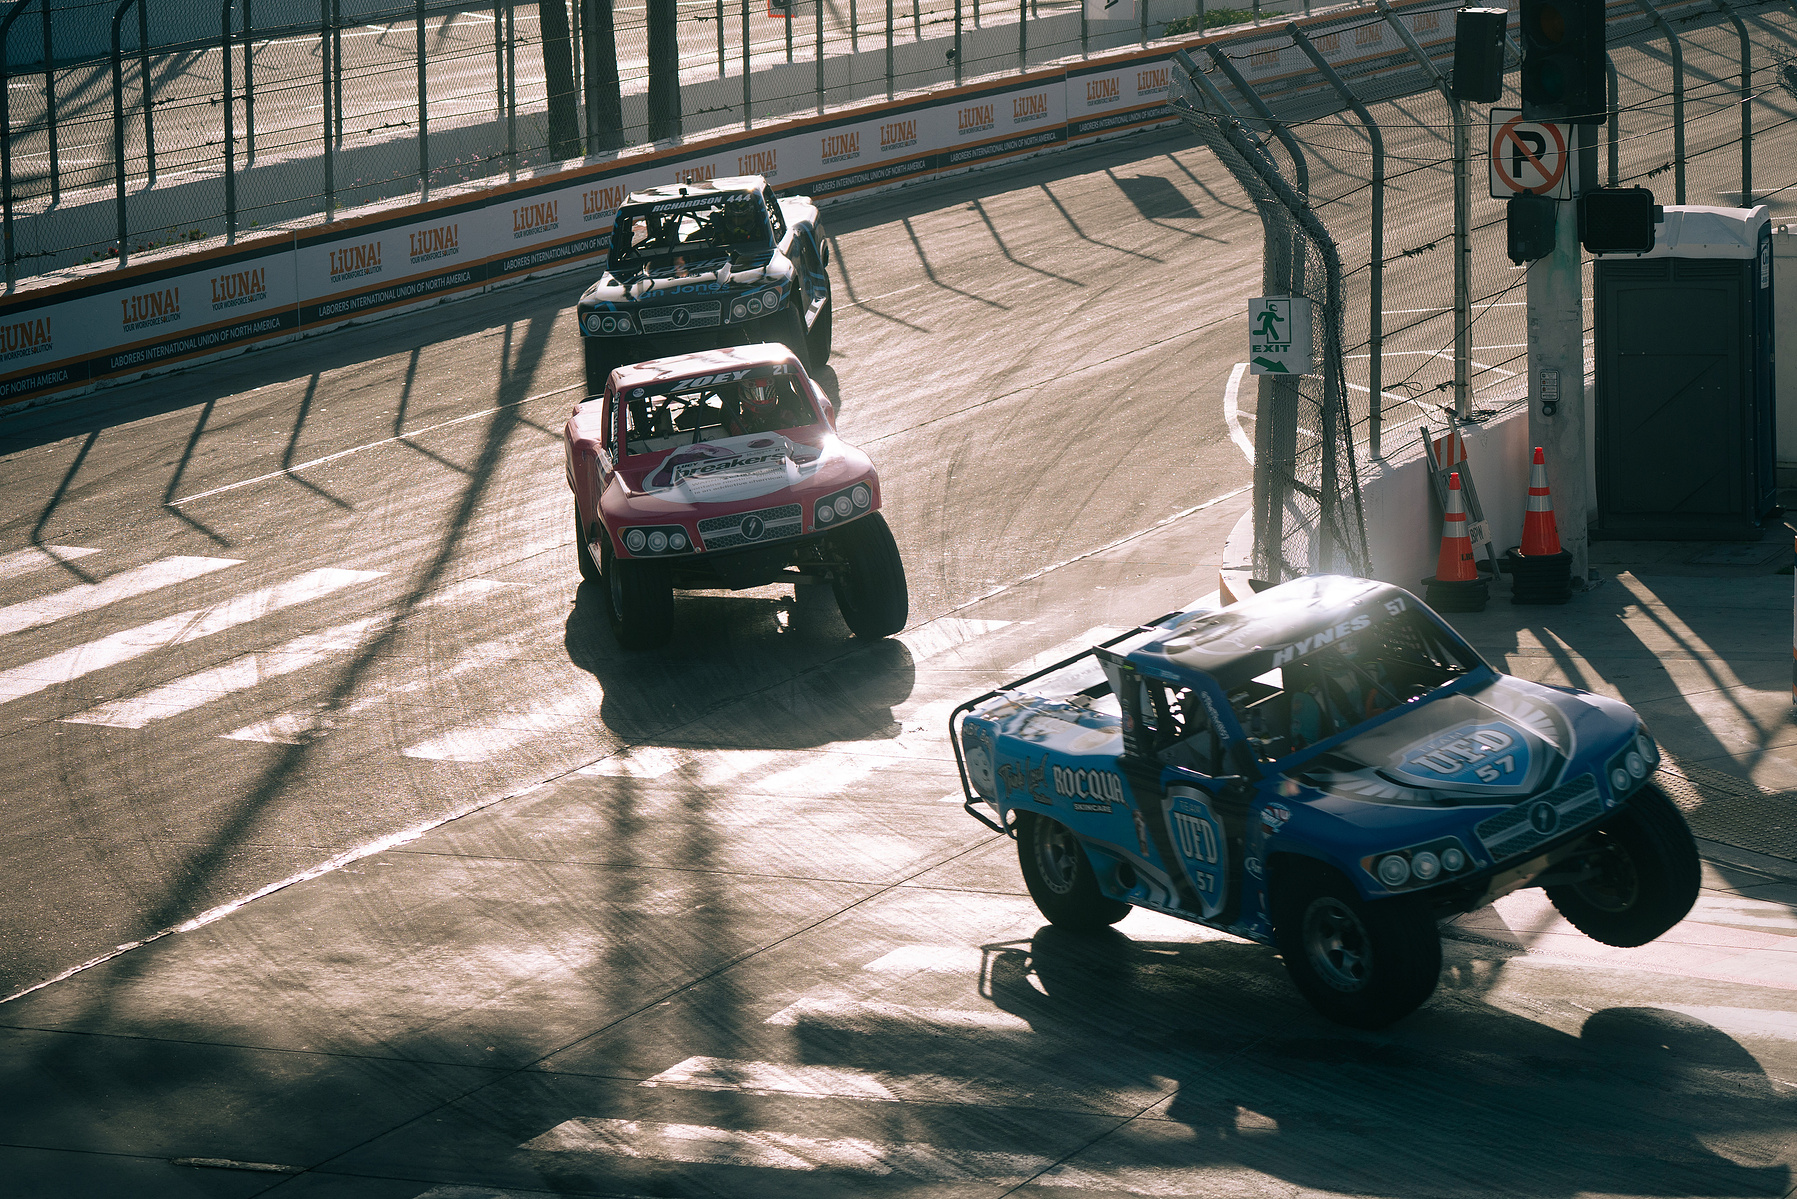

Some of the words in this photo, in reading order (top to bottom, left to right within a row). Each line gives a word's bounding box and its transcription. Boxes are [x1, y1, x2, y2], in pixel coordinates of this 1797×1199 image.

[1086, 77, 1119, 101] LiUNA!
[1137, 68, 1169, 91] LiUNA!
[958, 104, 994, 130] LiUNA!
[1013, 93, 1047, 118] LiUNA!
[821, 131, 860, 159] LiUNA!
[880, 119, 917, 146] LiUNA!
[738, 149, 777, 176] LiUNA!
[812, 180, 836, 193] LABORERS
[836, 173, 870, 188] INTERNATIONAL
[870, 169, 885, 179] UNION
[885, 167, 892, 176] OF
[892, 164, 907, 175] NORTH
[907, 160, 926, 171] AMERICA
[513, 200, 558, 232] LiUNA!
[652, 196, 722, 213] RICHARDSON
[726, 194, 751, 203] 444
[409, 224, 458, 257] LiUNA!
[503, 256, 531, 271] LABORERS
[530, 246, 571, 265] INTERNATIONAL
[572, 241, 589, 253] UNION
[589, 239, 596, 248] OF
[597, 235, 611, 247] NORT
[329, 241, 382, 276] LiUNA!
[210, 267, 266, 303] LiUNA!
[318, 300, 349, 317] LABORERS
[350, 289, 396, 309] INTERNATIONAL
[396, 285, 416, 298] UNION
[416, 282, 425, 293] OF
[426, 278, 445, 291] NORTH
[446, 271, 471, 286] AMERICA
[121, 287, 180, 324] LiUNA!
[0, 317, 51, 353] iUNA!
[110, 350, 145, 369] LABORERS
[145, 338, 197, 359] INTERNATIONAL
[198, 332, 219, 347] UNION
[220, 330, 230, 341] OF
[230, 324, 252, 339] NORTH
[253, 317, 280, 334] AMERICA
[1252, 345, 1290, 353] EXIT
[0, 385, 10, 396] OF
[11, 378, 36, 393] NORTH
[36, 370, 68, 386] AMERICA
[670, 369, 751, 392] ZOEY
[772, 364, 788, 376] 21
[675, 452, 785, 480] breakers
[1383, 597, 1407, 616] 57
[1272, 614, 1371, 668] HYNES
[1409, 729, 1514, 775] UFD
[1474, 754, 1515, 783] 57
[1052, 764, 1129, 810] ROCQUA
[1074, 803, 1112, 814] SKINCARE
[1173, 810, 1217, 865] UFD
[1196, 869, 1214, 894] 57
